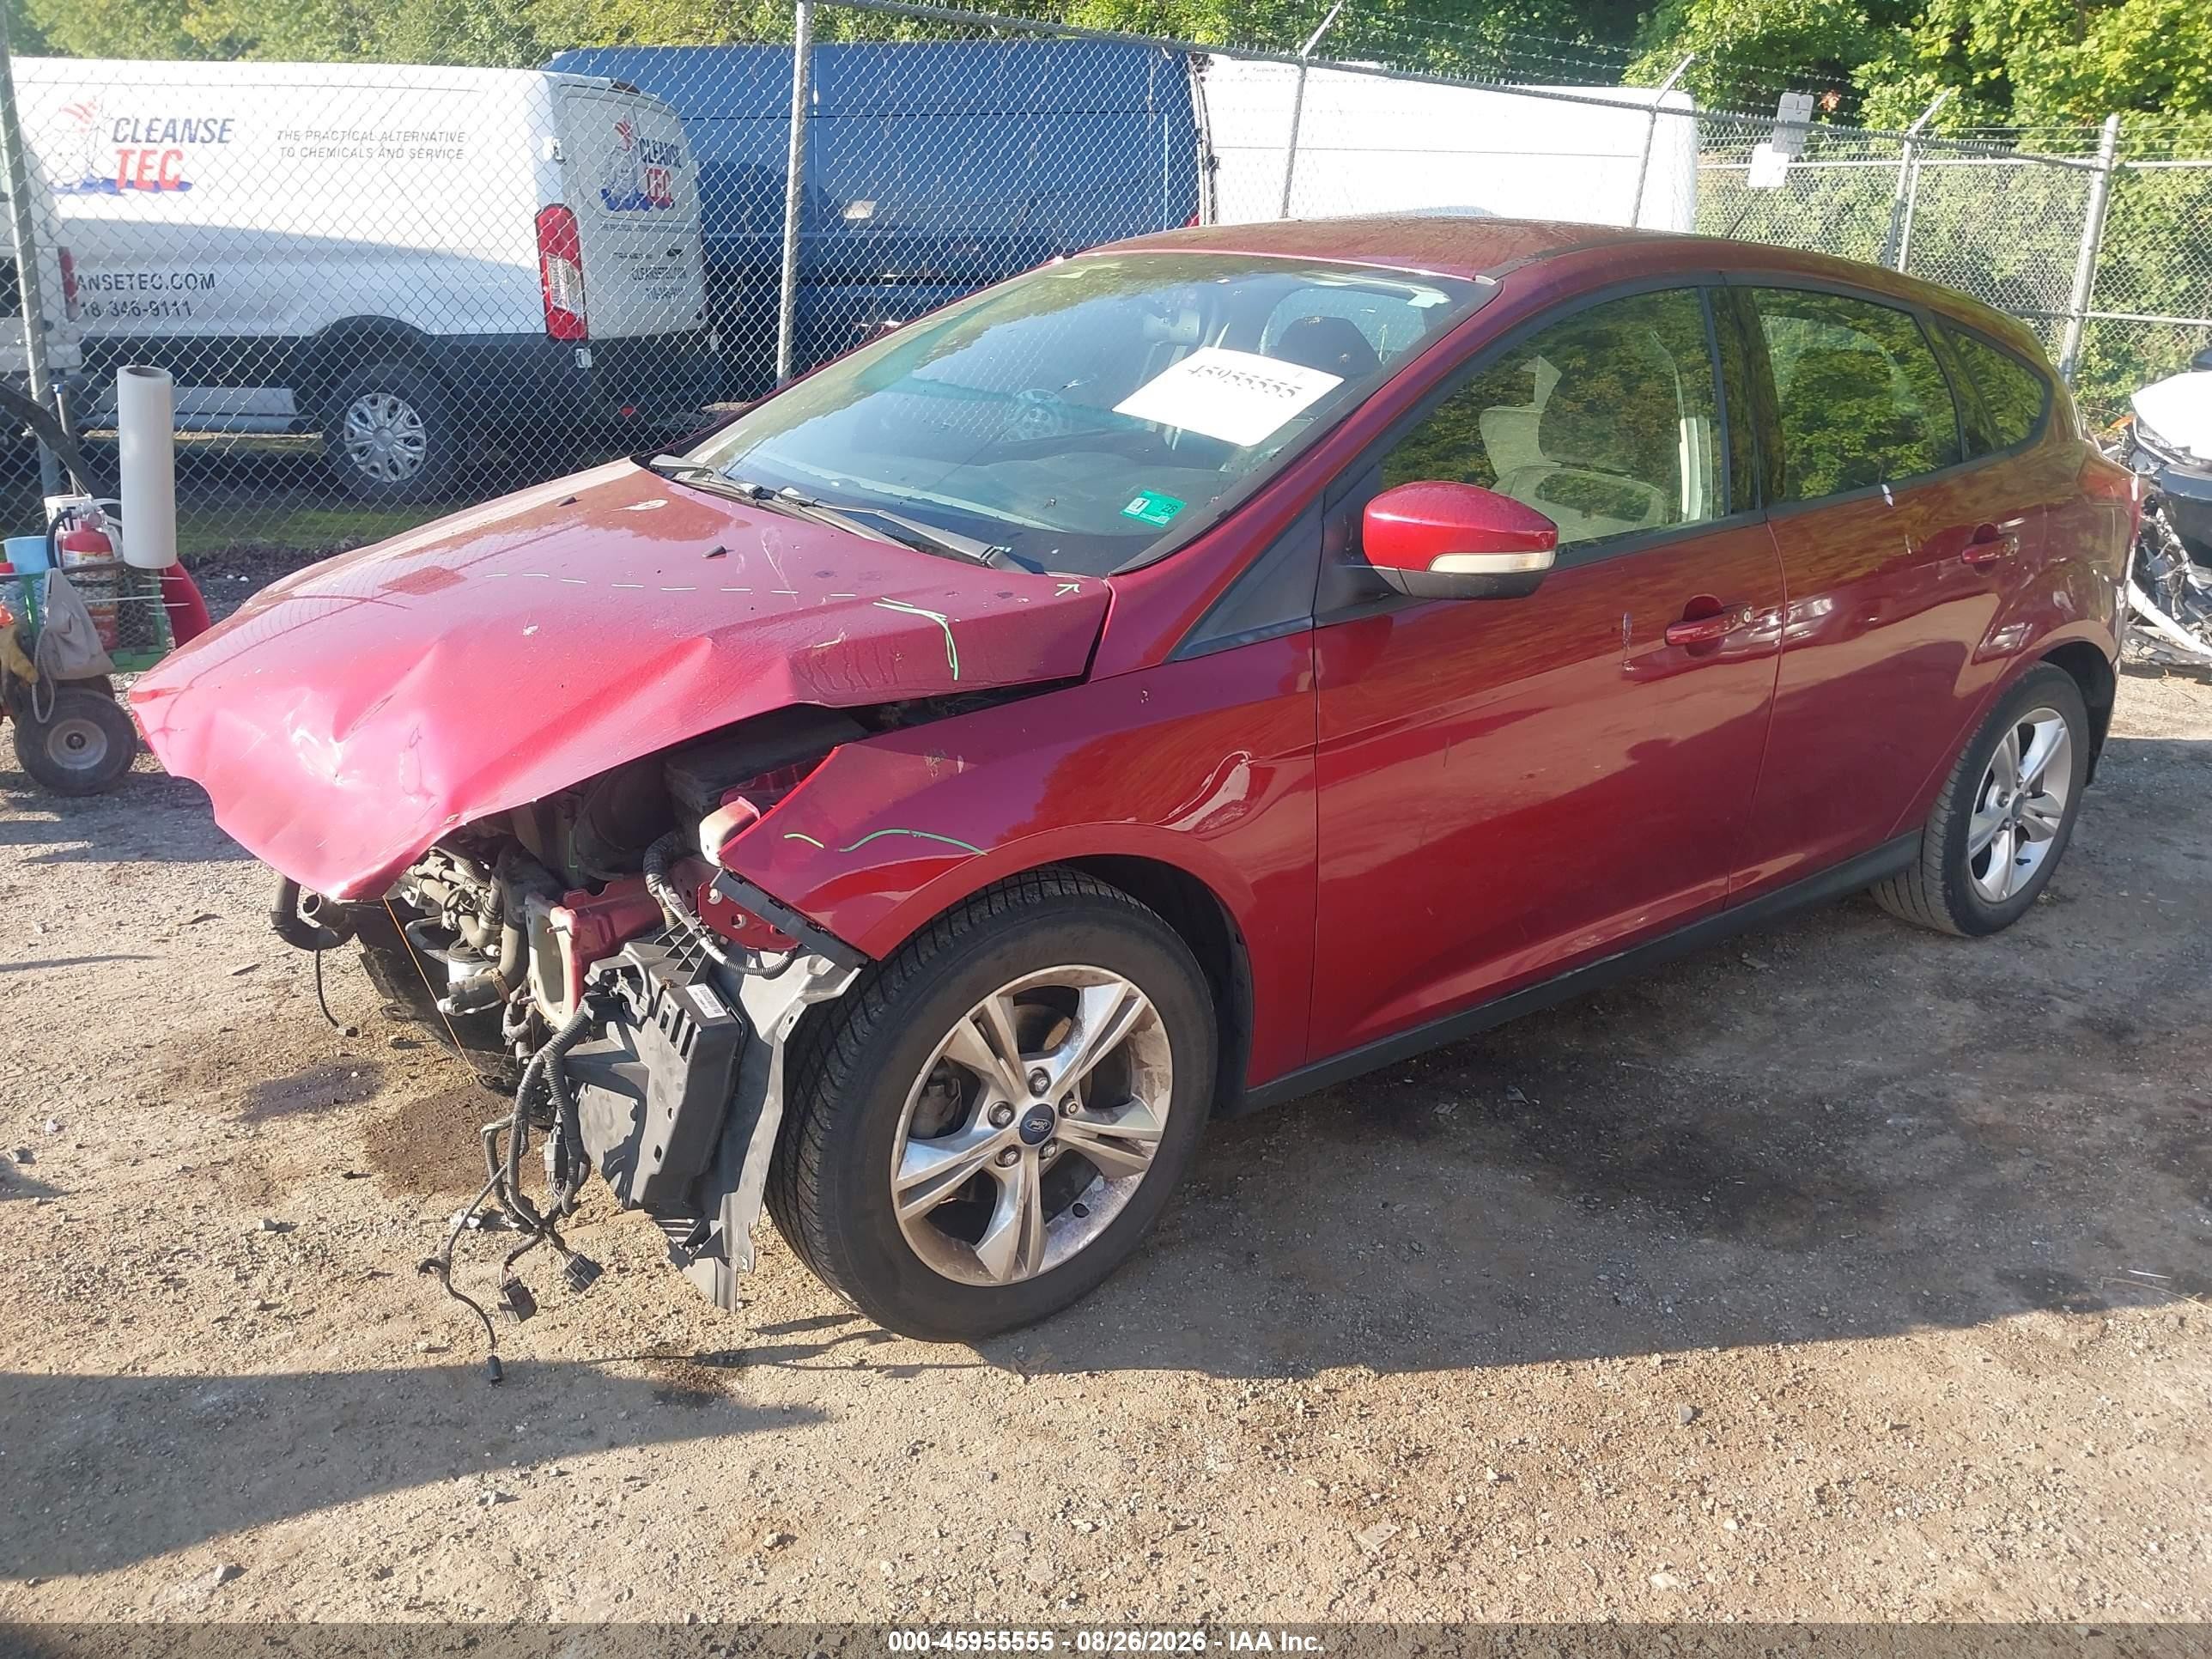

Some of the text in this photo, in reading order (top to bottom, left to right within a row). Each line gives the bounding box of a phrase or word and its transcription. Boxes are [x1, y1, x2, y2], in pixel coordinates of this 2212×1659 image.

[112, 117, 235, 143] CLEANSE
[277, 130, 466, 143] THE PRACTICAL ALTERNATIVE
[279, 146, 465, 161] TO CHEMICALS AND SERVICE
[114, 148, 184, 191] TEC
